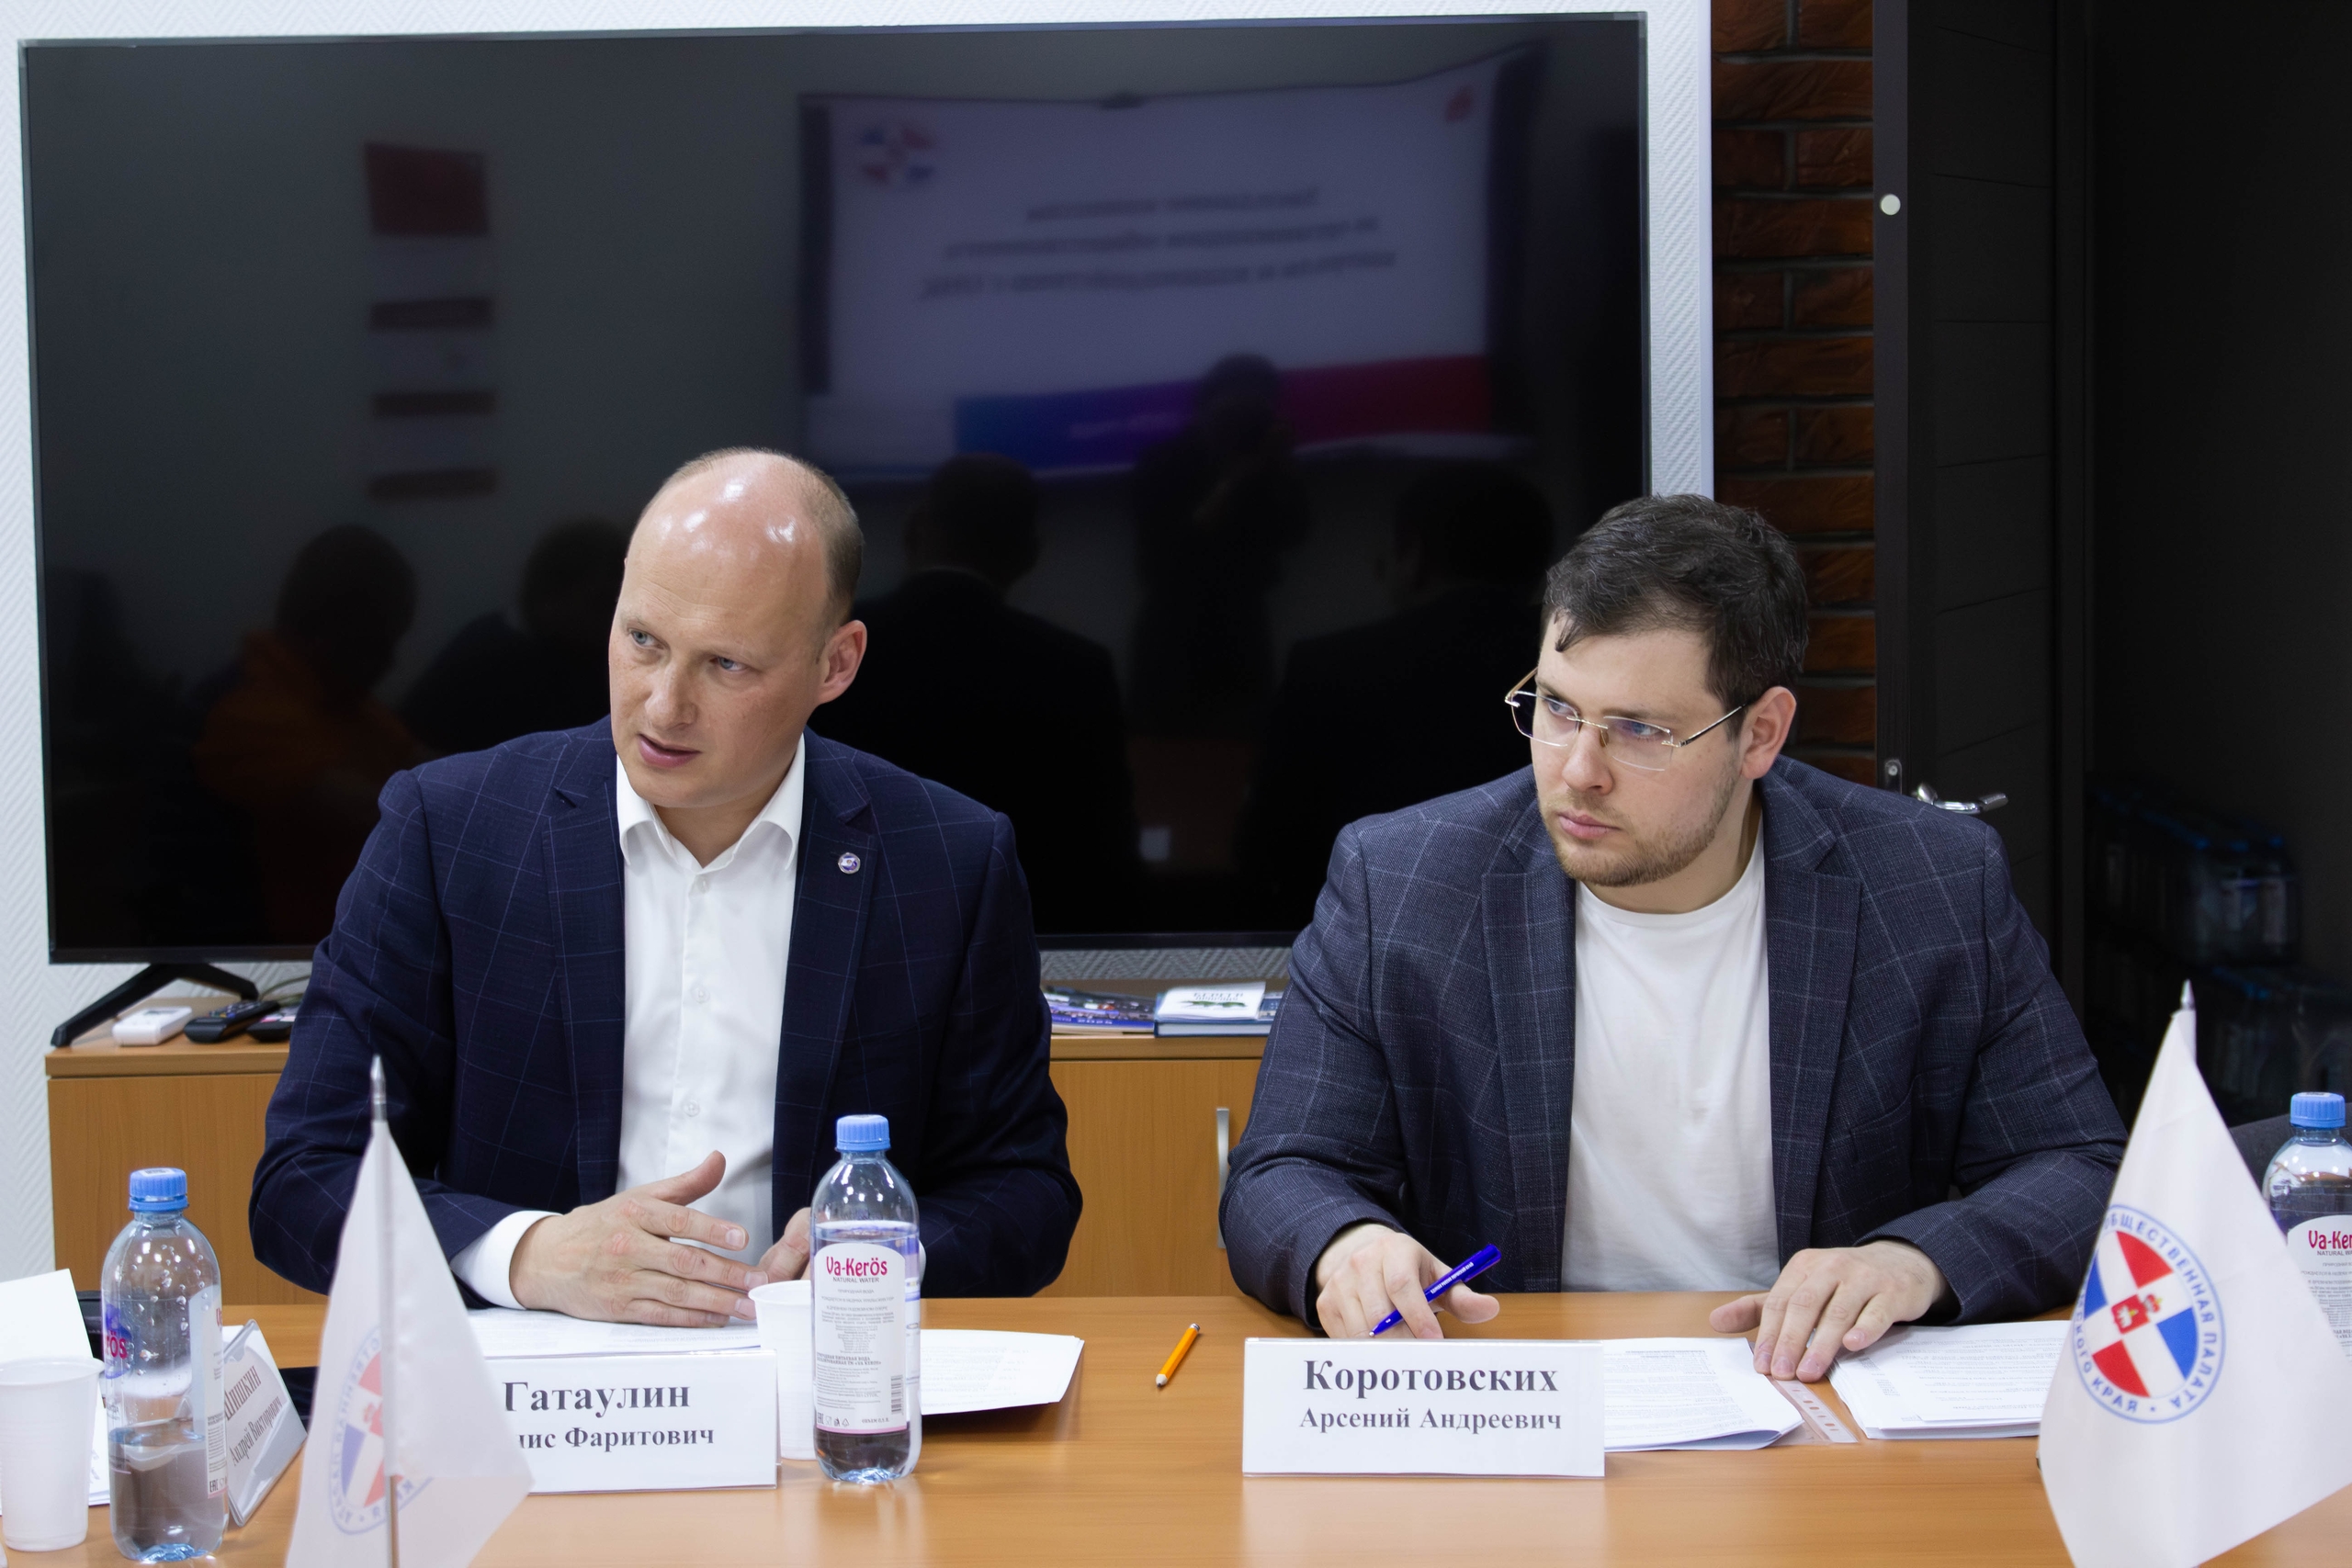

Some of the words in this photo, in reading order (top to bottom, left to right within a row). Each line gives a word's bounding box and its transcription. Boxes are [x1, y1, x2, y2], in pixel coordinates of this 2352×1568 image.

[826, 1256, 888, 1277] Va-Kerös
[1303, 1359, 1559, 1400] Коротовских
[2169, 1332, 2217, 1408] ПАЛАТА
[503, 1381, 691, 1418] Гатаулин
[2091, 1377, 2138, 1412] КРАЯ
[229, 1427, 254, 1467] Андрей
[248, 1396, 283, 1441] Викторович
[1299, 1407, 1411, 1433] Арсений
[1419, 1408, 1562, 1435] Андреевич
[519, 1433, 556, 1450] ис
[564, 1427, 714, 1453] Фаритович
